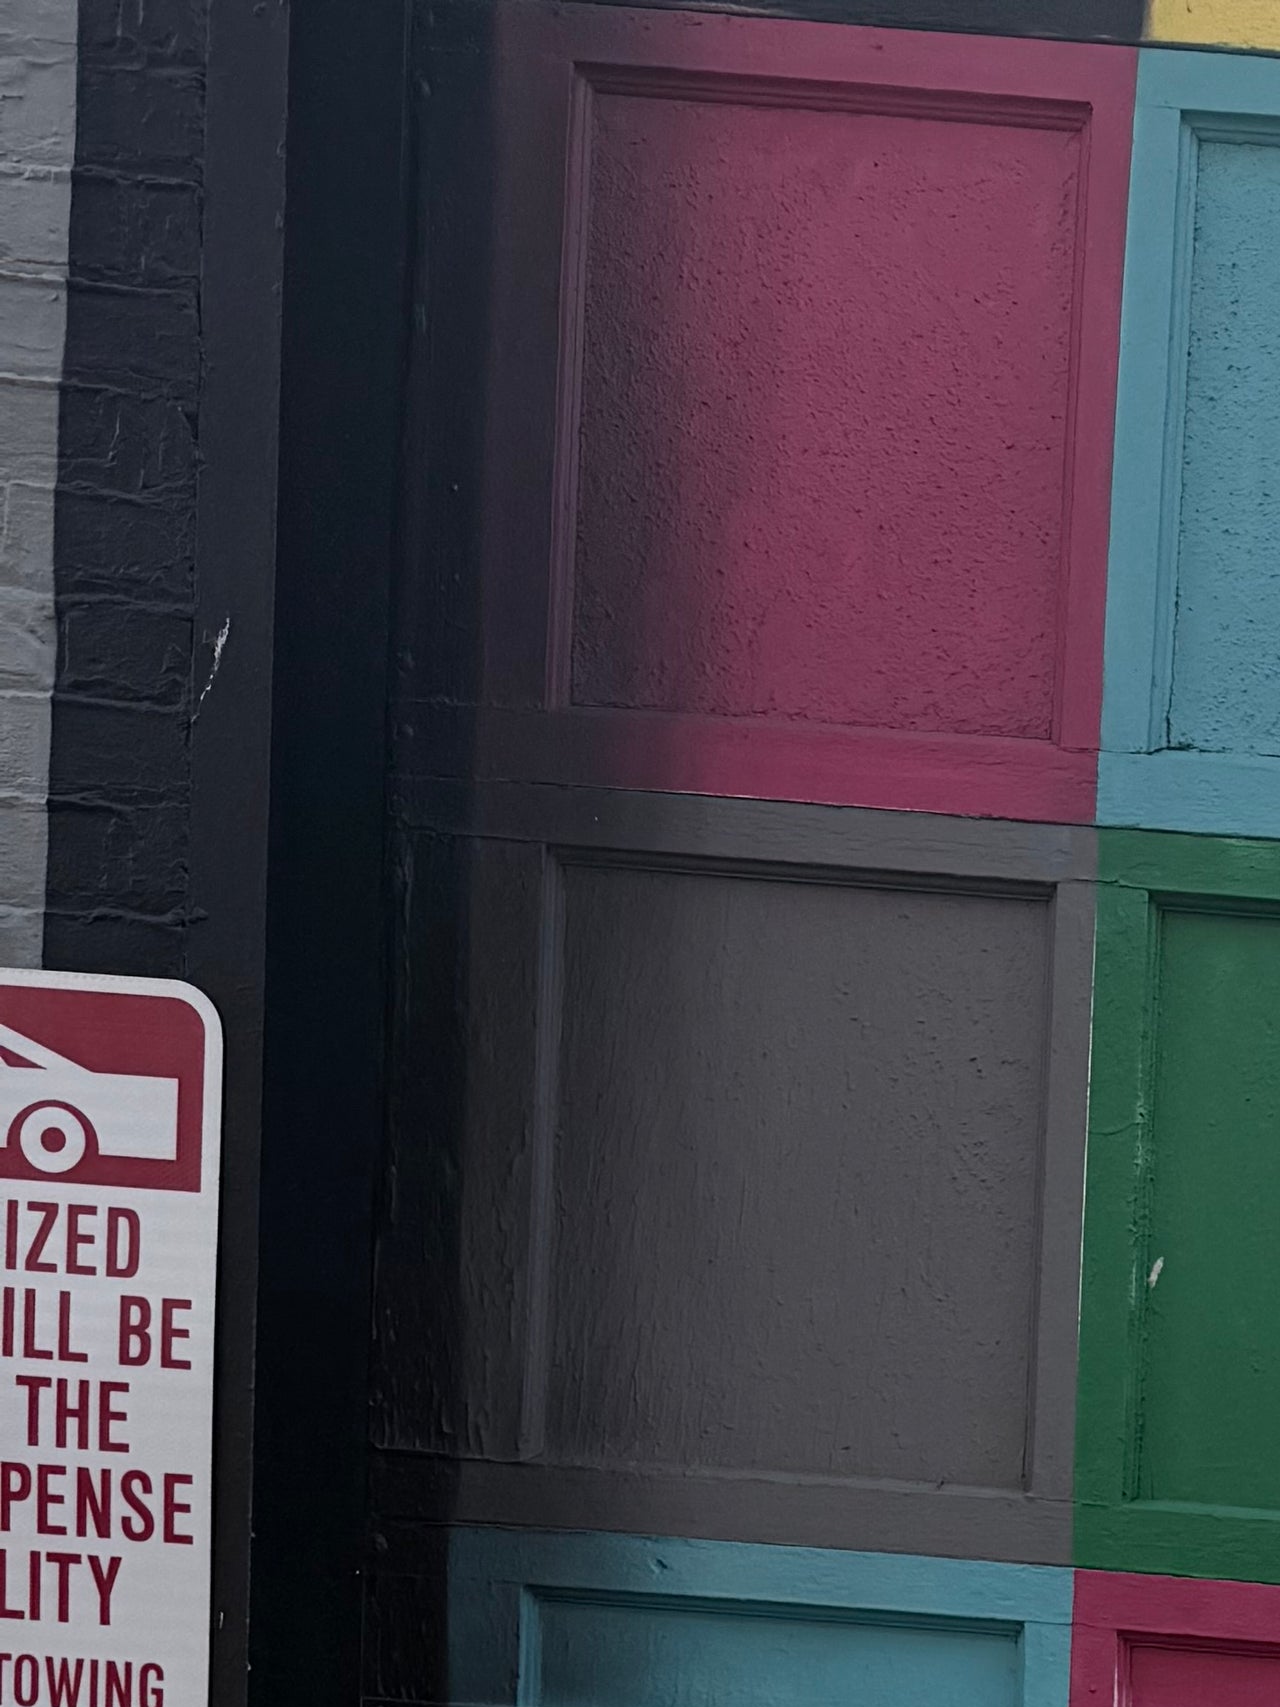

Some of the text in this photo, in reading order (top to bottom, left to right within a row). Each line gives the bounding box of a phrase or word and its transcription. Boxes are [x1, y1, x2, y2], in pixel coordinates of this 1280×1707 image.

[6, 1200, 140, 1278] IZED
[2, 1287, 191, 1370] ILL BE
[16, 1375, 129, 1453] THE
[0, 1461, 193, 1545] PENSE
[0, 1549, 122, 1625] LITY
